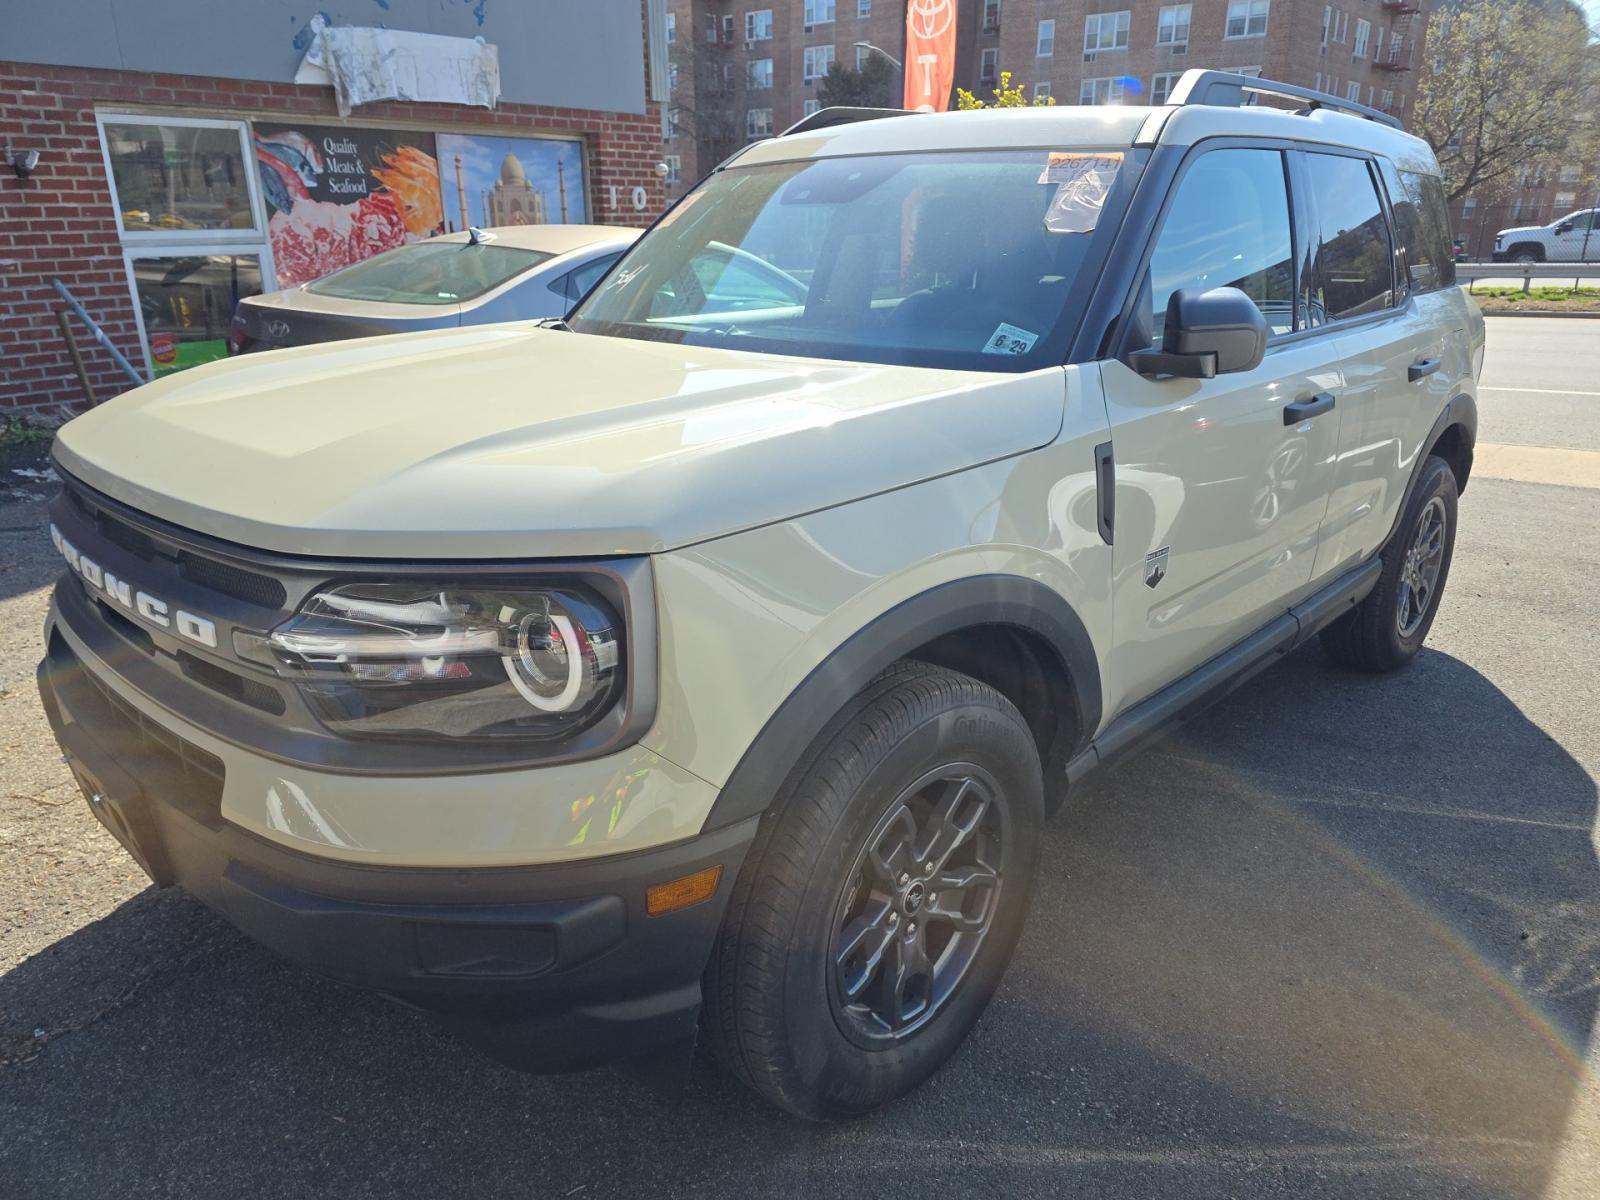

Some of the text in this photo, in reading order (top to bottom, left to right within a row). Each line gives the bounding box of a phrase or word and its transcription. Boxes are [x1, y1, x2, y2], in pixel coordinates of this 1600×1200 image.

[323, 137, 359, 157] Quality
[326, 157, 366, 175] Meats &
[328, 177, 367, 194] Seafood
[995, 334, 1028, 353] 6 29
